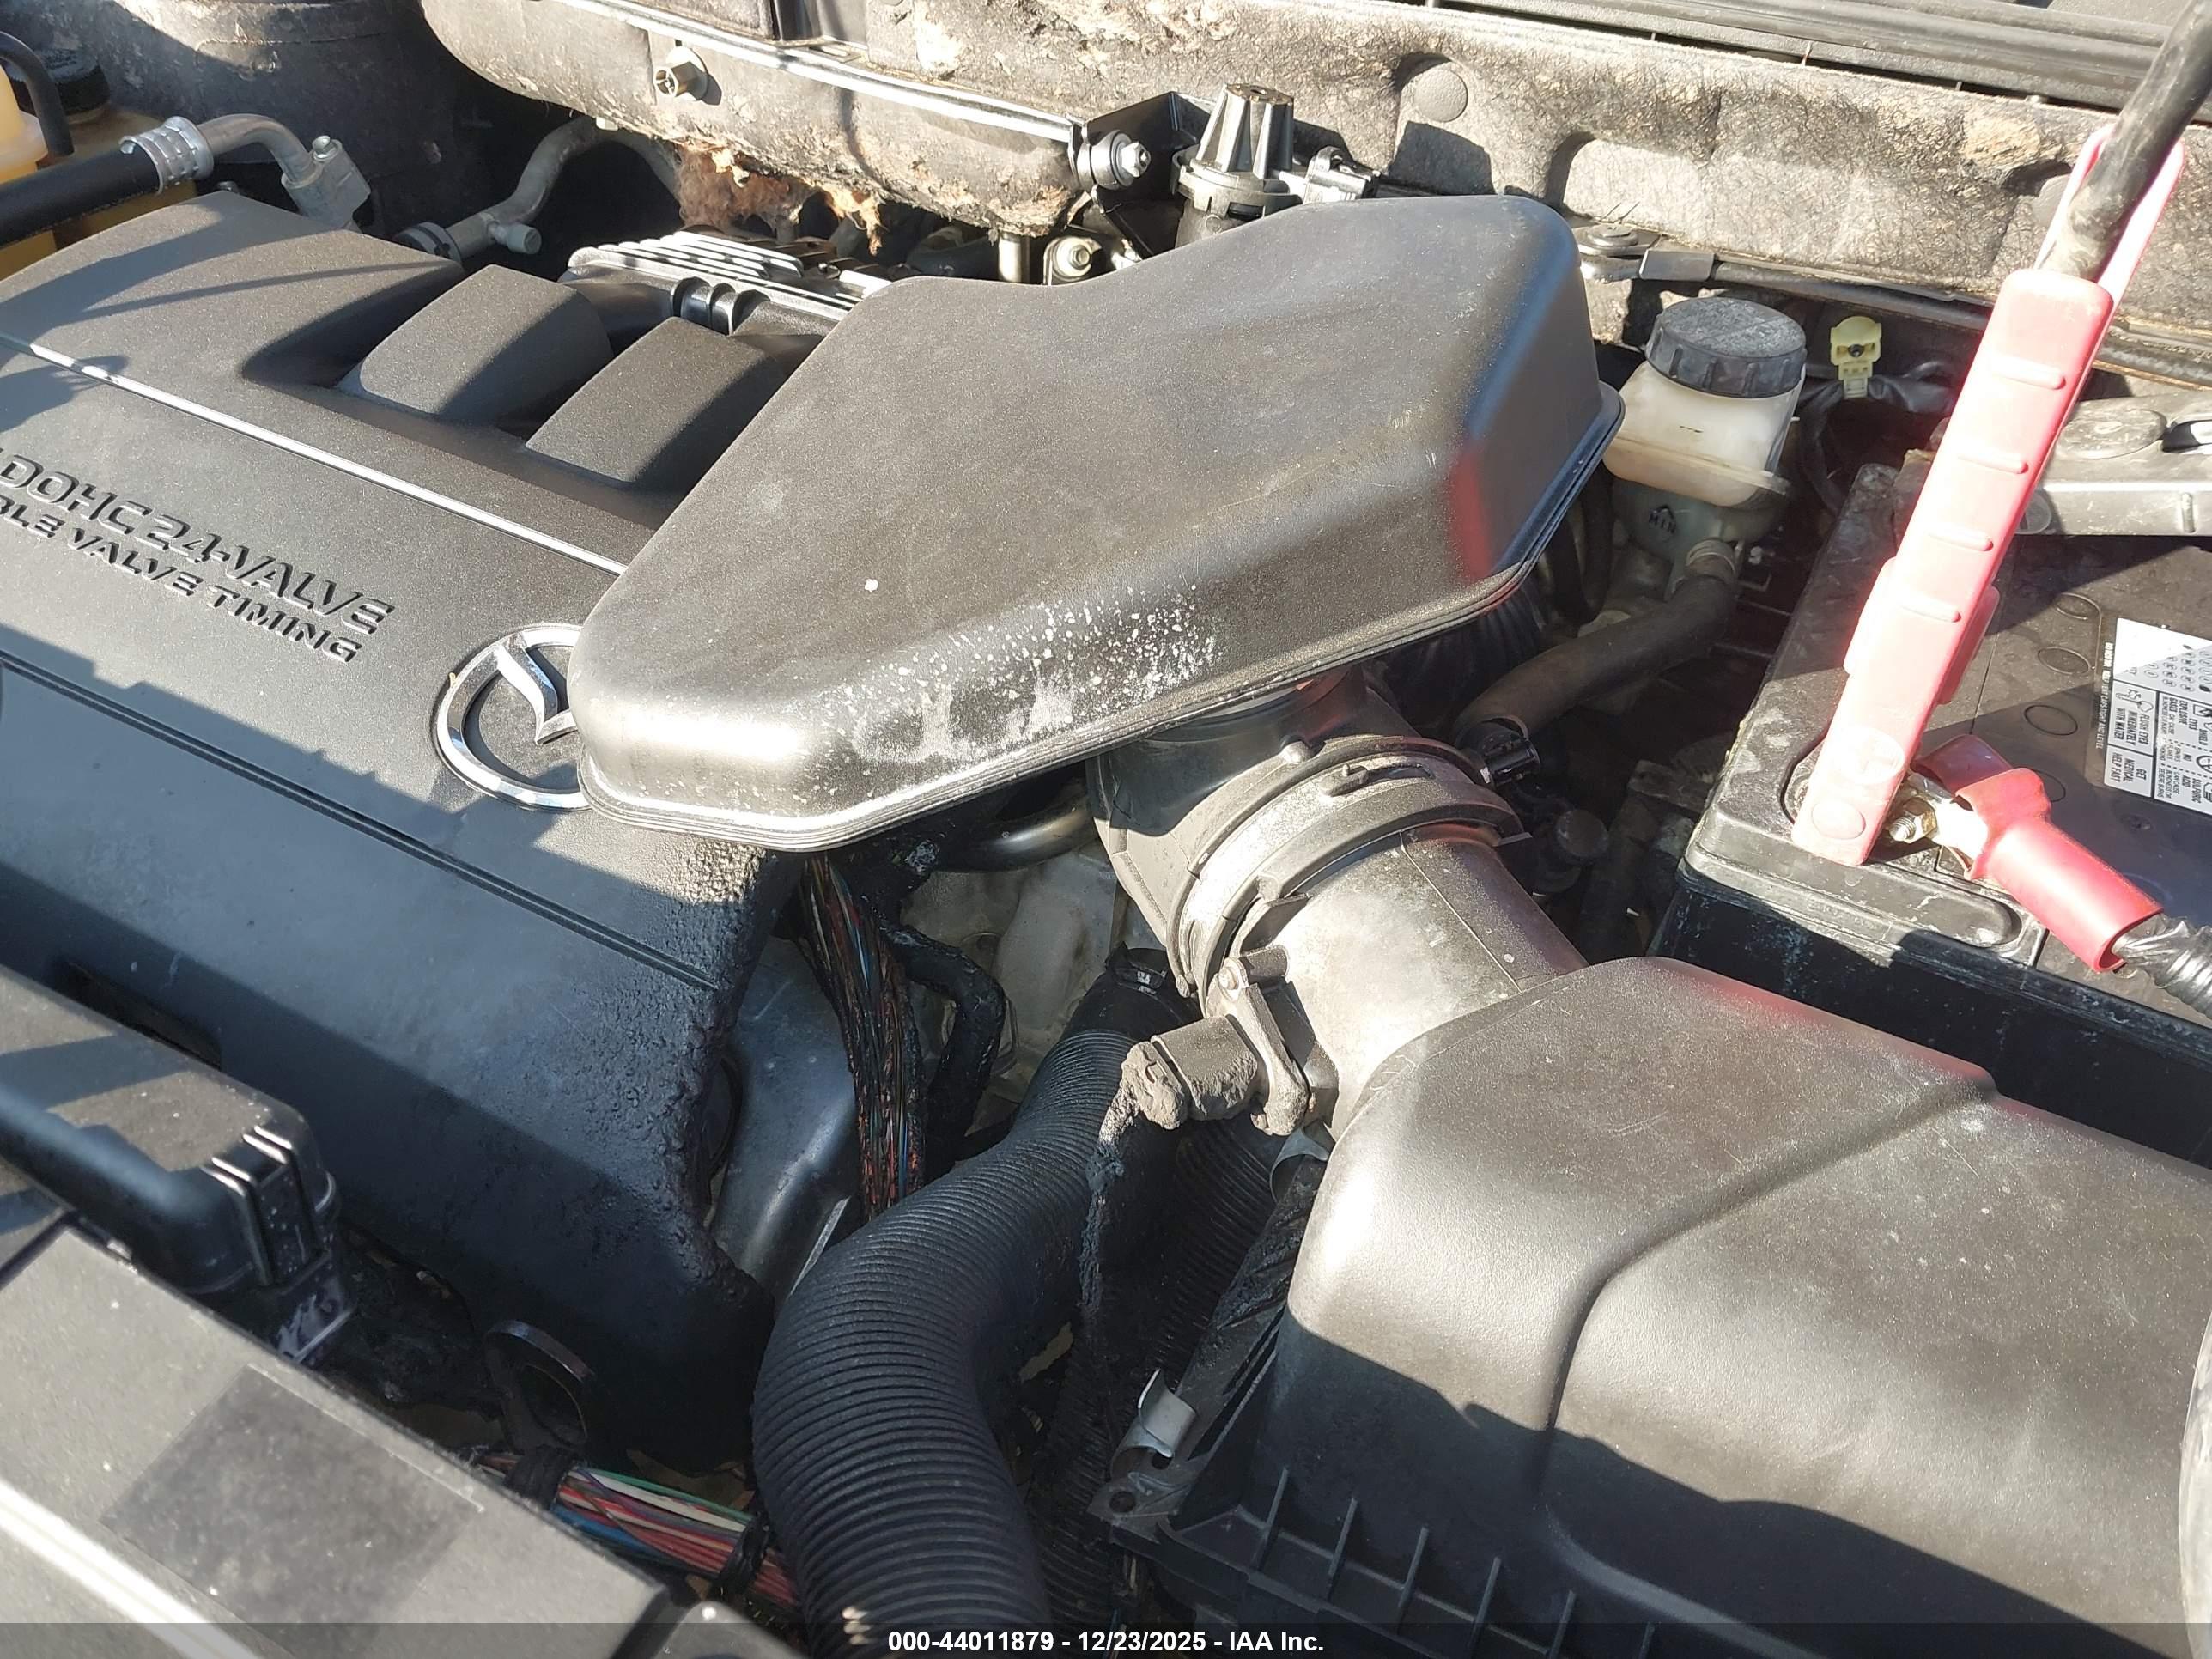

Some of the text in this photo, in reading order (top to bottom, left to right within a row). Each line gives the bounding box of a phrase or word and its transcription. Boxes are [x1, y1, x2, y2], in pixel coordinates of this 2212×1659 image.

[0, 454, 396, 635] DOHC 24-VALVE
[67, 527, 204, 597] VALVE
[207, 585, 363, 663] TIMING
[2114, 707, 2125, 740] WITH WATER
[2179, 700, 2189, 725] EXPLOSIVE
[2188, 718, 2198, 731] EYES
[2095, 732, 2105, 749] LEVEL
[2126, 710, 2138, 745] IMMEDIATELY
[2138, 713, 2150, 745] FLUSH EYES
[2110, 752, 2123, 782] HELP FAST
[2123, 757, 2136, 782] MEDICAL
[2183, 753, 2193, 763] NO
[2136, 768, 2148, 781] GET
[2182, 775, 2191, 787] ACID
[2191, 777, 2202, 804] SULFURIC
